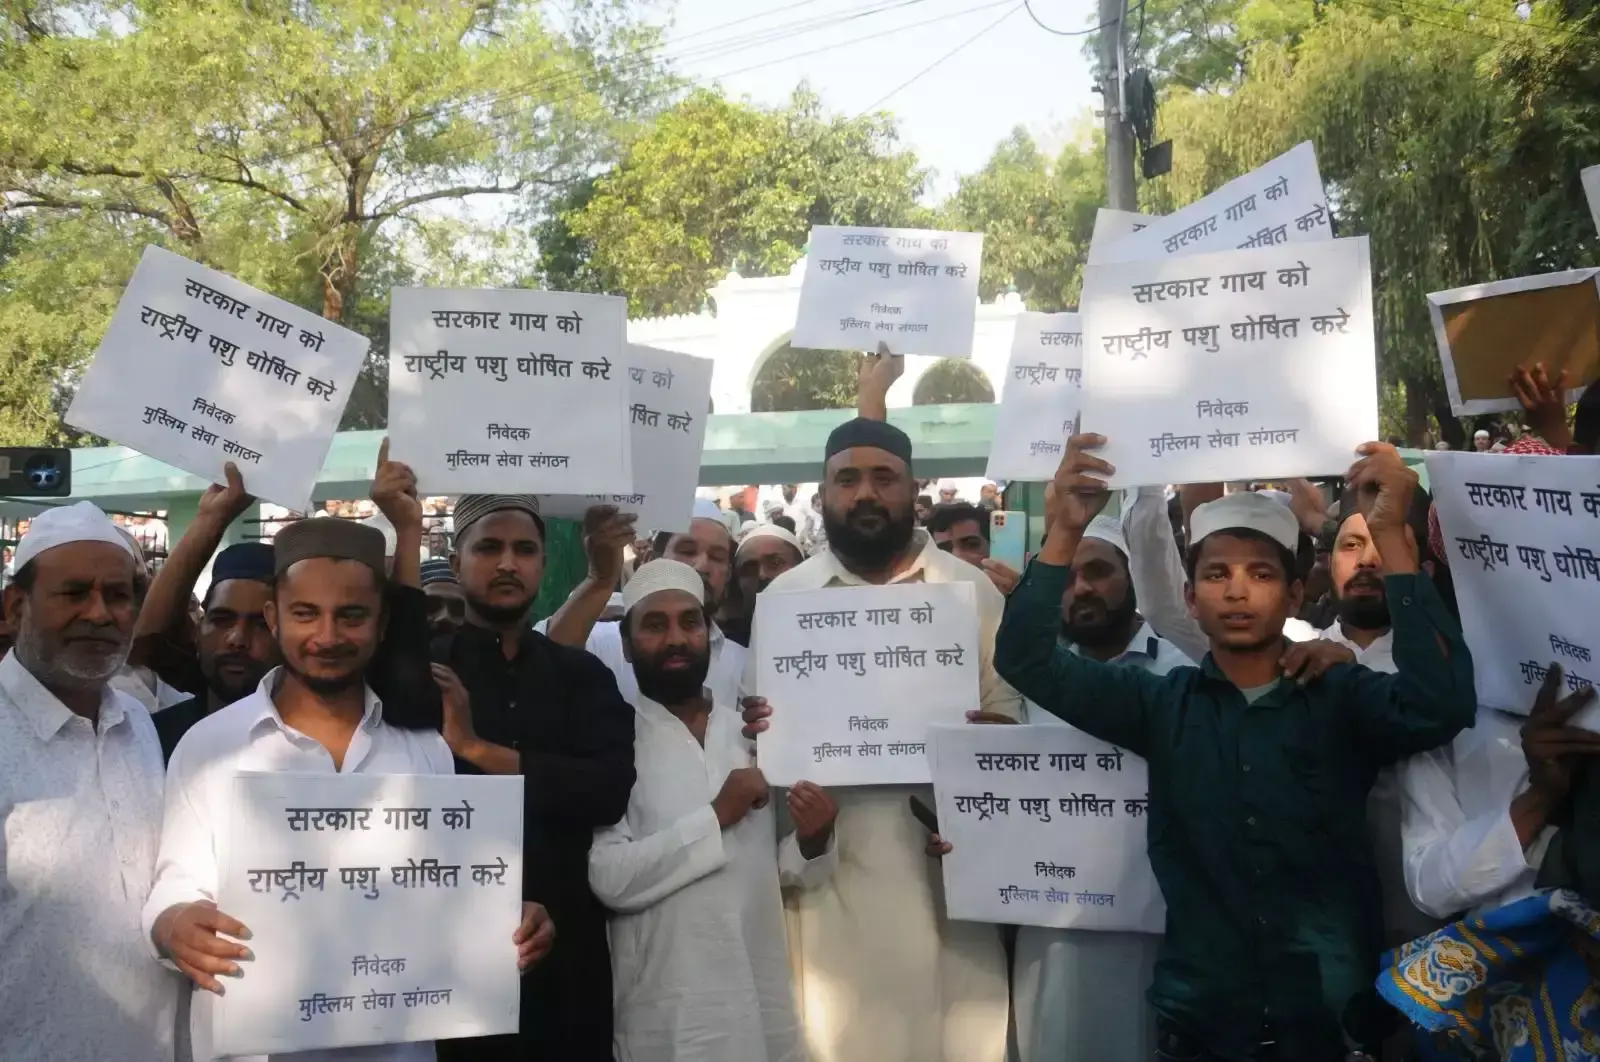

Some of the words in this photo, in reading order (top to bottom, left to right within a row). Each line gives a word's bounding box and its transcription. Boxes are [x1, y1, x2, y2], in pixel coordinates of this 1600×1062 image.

[1162, 214, 1219, 253] सरकार
[1223, 194, 1257, 222] गाय
[1264, 176, 1289, 200] को
[1294, 203, 1327, 232] करे
[842, 234, 890, 247] सरकार
[819, 258, 863, 275] राष्ट्रीय
[869, 262, 891, 278] पशु
[899, 261, 938, 276] घोषित
[945, 263, 968, 277] करे
[1132, 275, 1211, 304] सरकार
[1220, 270, 1267, 293] गाय
[1277, 261, 1311, 287] को
[184, 277, 250, 319] सरकार
[256, 312, 293, 338] गाय
[299, 329, 325, 353] को
[871, 303, 902, 314] निवेदक
[432, 310, 500, 329] सरकार
[509, 312, 547, 331] गाय
[556, 311, 583, 335] को
[839, 318, 870, 330] मुस्लिम
[875, 321, 893, 331] सेवा
[898, 323, 928, 332] संगठन
[1102, 326, 1171, 360] राष्ट्रीय
[1181, 326, 1221, 352] पशु
[1231, 314, 1300, 341] घोषित
[1311, 308, 1351, 335] करे
[1040, 332, 1082, 347] सरका
[140, 305, 201, 343] राष्ट्रीय
[209, 335, 240, 365] पशु
[247, 348, 300, 386] घोषित
[306, 375, 337, 402] करे
[404, 351, 467, 379] राष्ट्रीय
[476, 356, 507, 381] पशु
[517, 353, 573, 378] घोषित
[582, 357, 611, 380] करे
[652, 369, 674, 389] को
[1015, 362, 1059, 386] राष्ट्रीय
[192, 398, 236, 425] निवेदक
[667, 411, 692, 434] करे
[1196, 400, 1249, 419] निवेदक
[142, 406, 186, 434] मुस्लिम
[192, 420, 218, 446] सेवा
[223, 438, 263, 464] संगठन
[487, 424, 531, 440] निवेदक
[1149, 434, 1200, 458] मुस्लिम
[1208, 430, 1239, 448] सेवा
[1247, 427, 1299, 446] संगठन
[446, 450, 490, 470] मुस्लिम
[496, 450, 523, 467] सेवा
[529, 452, 569, 468] संगठन
[1030, 440, 1061, 456] मुस्लिम
[1465, 482, 1528, 510] सरकार
[1533, 487, 1572, 515] गाय
[1455, 534, 1508, 572] राष्ट्रीय
[1516, 544, 1552, 582] पशु
[797, 609, 857, 629] सरकार
[866, 608, 901, 626] गाय
[910, 602, 935, 624] को
[1549, 633, 1591, 662] निवेदक
[773, 649, 828, 679] राष्ट्रीय
[837, 653, 867, 676] पशु
[873, 645, 927, 668] घोषित
[936, 644, 965, 667] करे
[848, 717, 889, 731] निवेदक
[813, 743, 852, 763] मुस्लिम
[858, 742, 882, 757] सेवा
[888, 739, 926, 756] संगठन
[975, 752, 1040, 773] सरकार
[1049, 753, 1087, 772] गाय
[1096, 747, 1123, 773] को
[285, 807, 372, 831] सरकार
[383, 807, 431, 830] गाय
[442, 800, 474, 829] को
[954, 794, 1010, 822] राष्ट्रीय
[1019, 797, 1053, 822] पशु
[1059, 793, 1114, 818] घोषित
[248, 862, 328, 901] राष्ट्रीय
[339, 865, 379, 899] पशु
[391, 858, 460, 888] घोषित
[471, 857, 508, 886] करे
[1034, 862, 1076, 879] निवेदक
[999, 887, 1039, 904] मुस्लिम
[1045, 888, 1069, 903] सेवा
[1076, 890, 1115, 908] संगठन
[352, 955, 406, 976] निवेदक
[300, 994, 355, 1021] मुस्लिम
[362, 989, 396, 1010] सेवा
[403, 987, 452, 1007] संगठन
